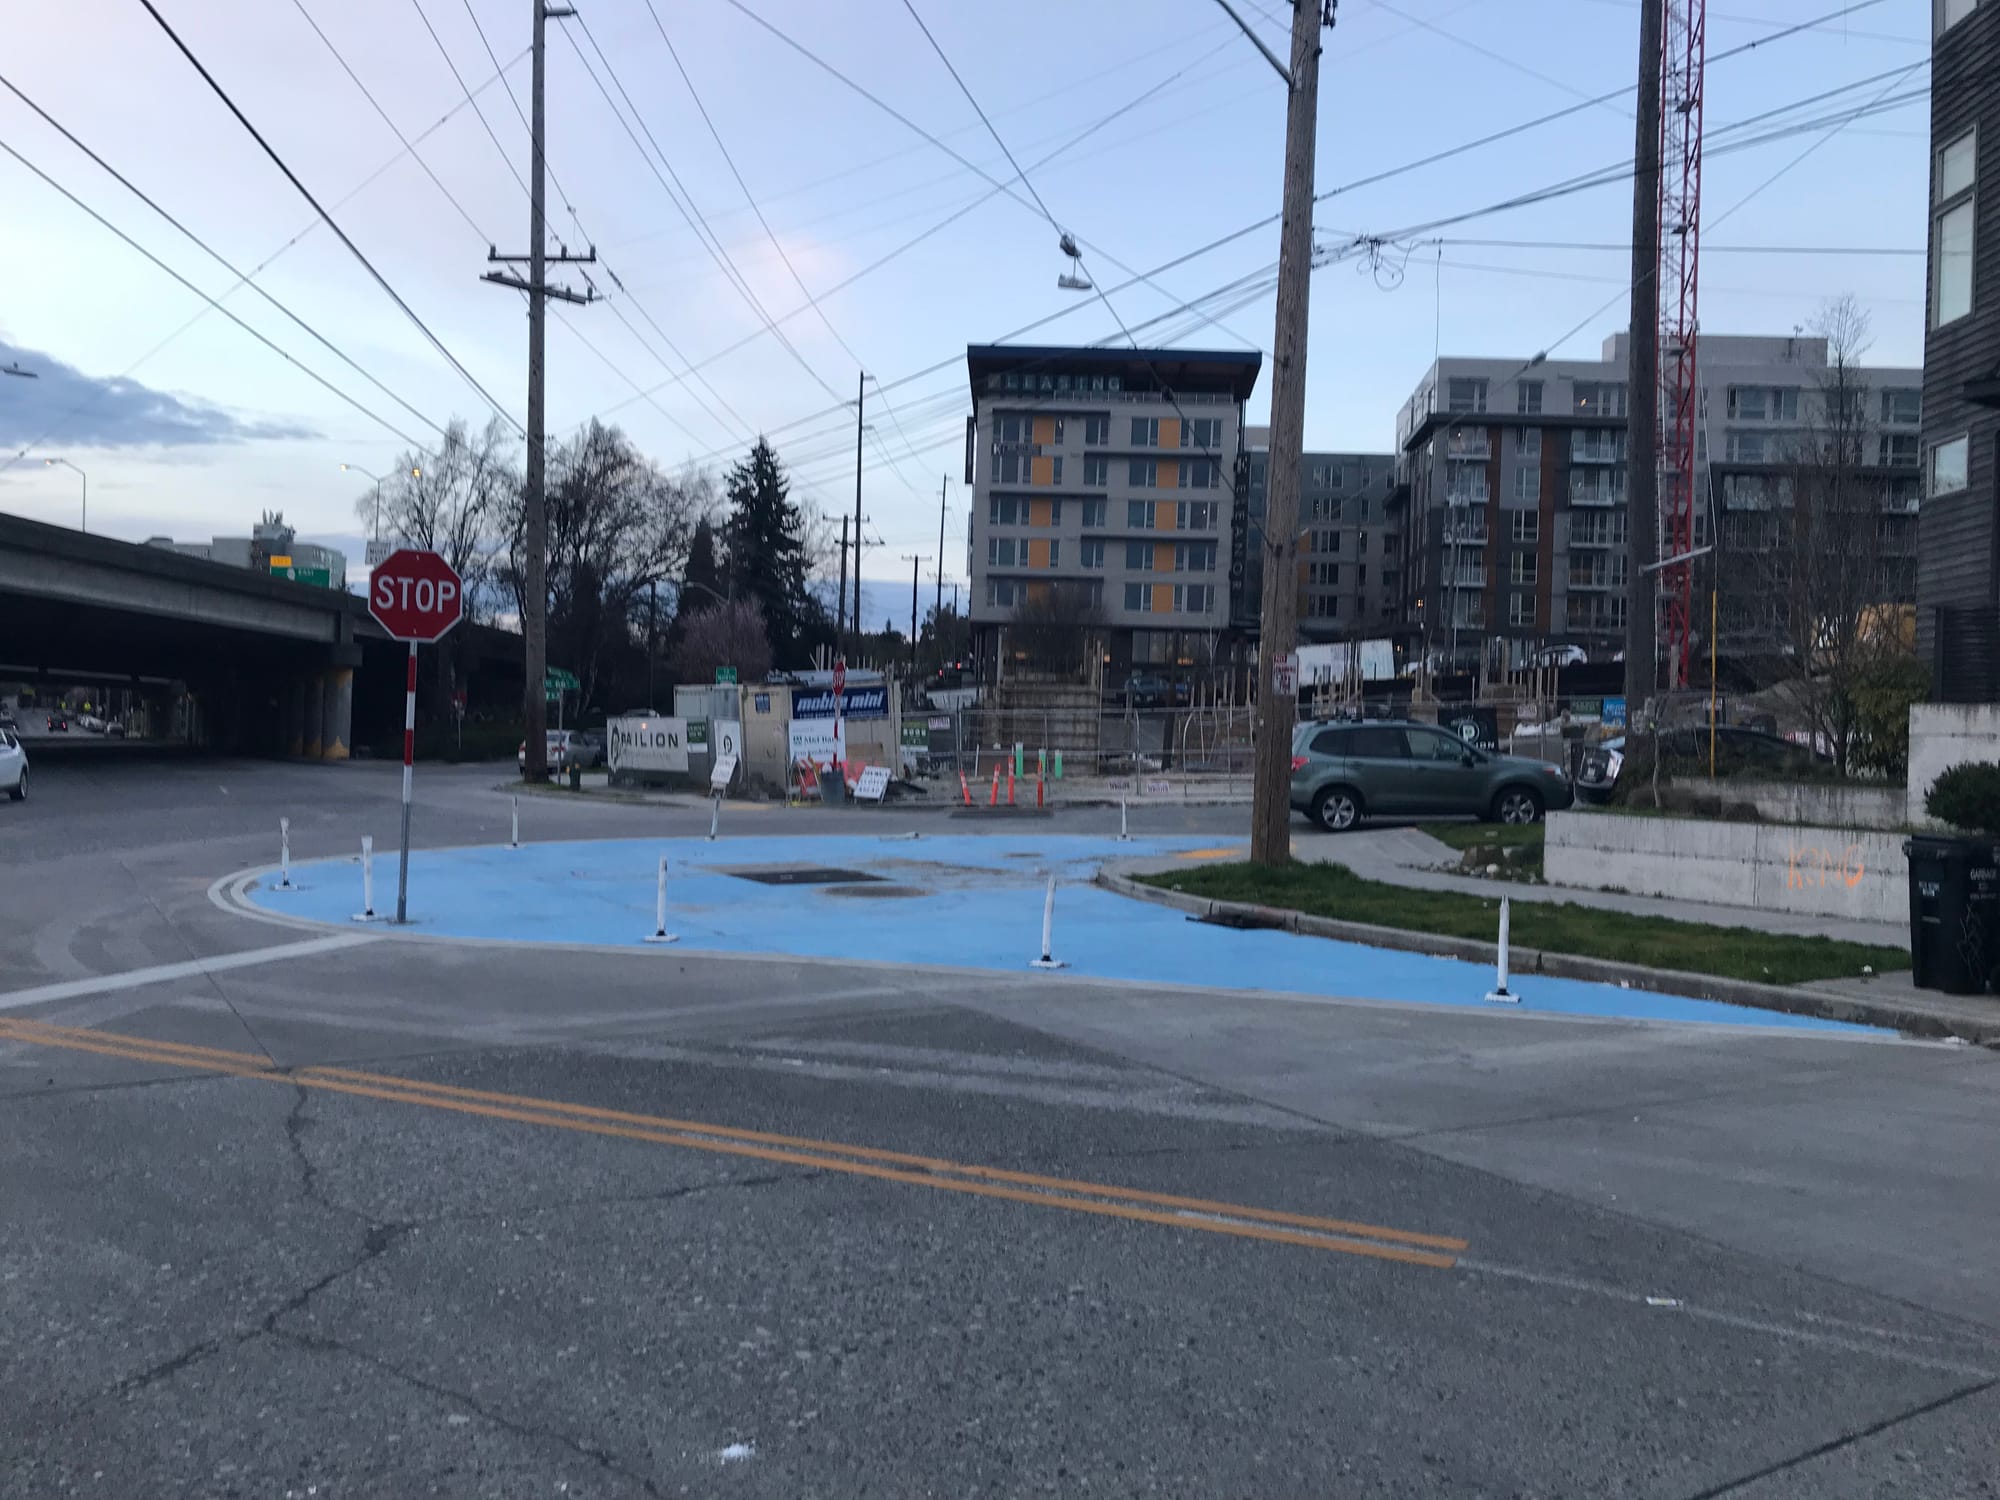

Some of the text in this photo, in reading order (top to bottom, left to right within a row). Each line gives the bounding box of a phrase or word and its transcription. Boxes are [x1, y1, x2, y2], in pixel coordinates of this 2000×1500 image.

[1007, 375, 1119, 390] LEASING
[375, 575, 456, 613] STOP
[797, 691, 848, 711] mobie
